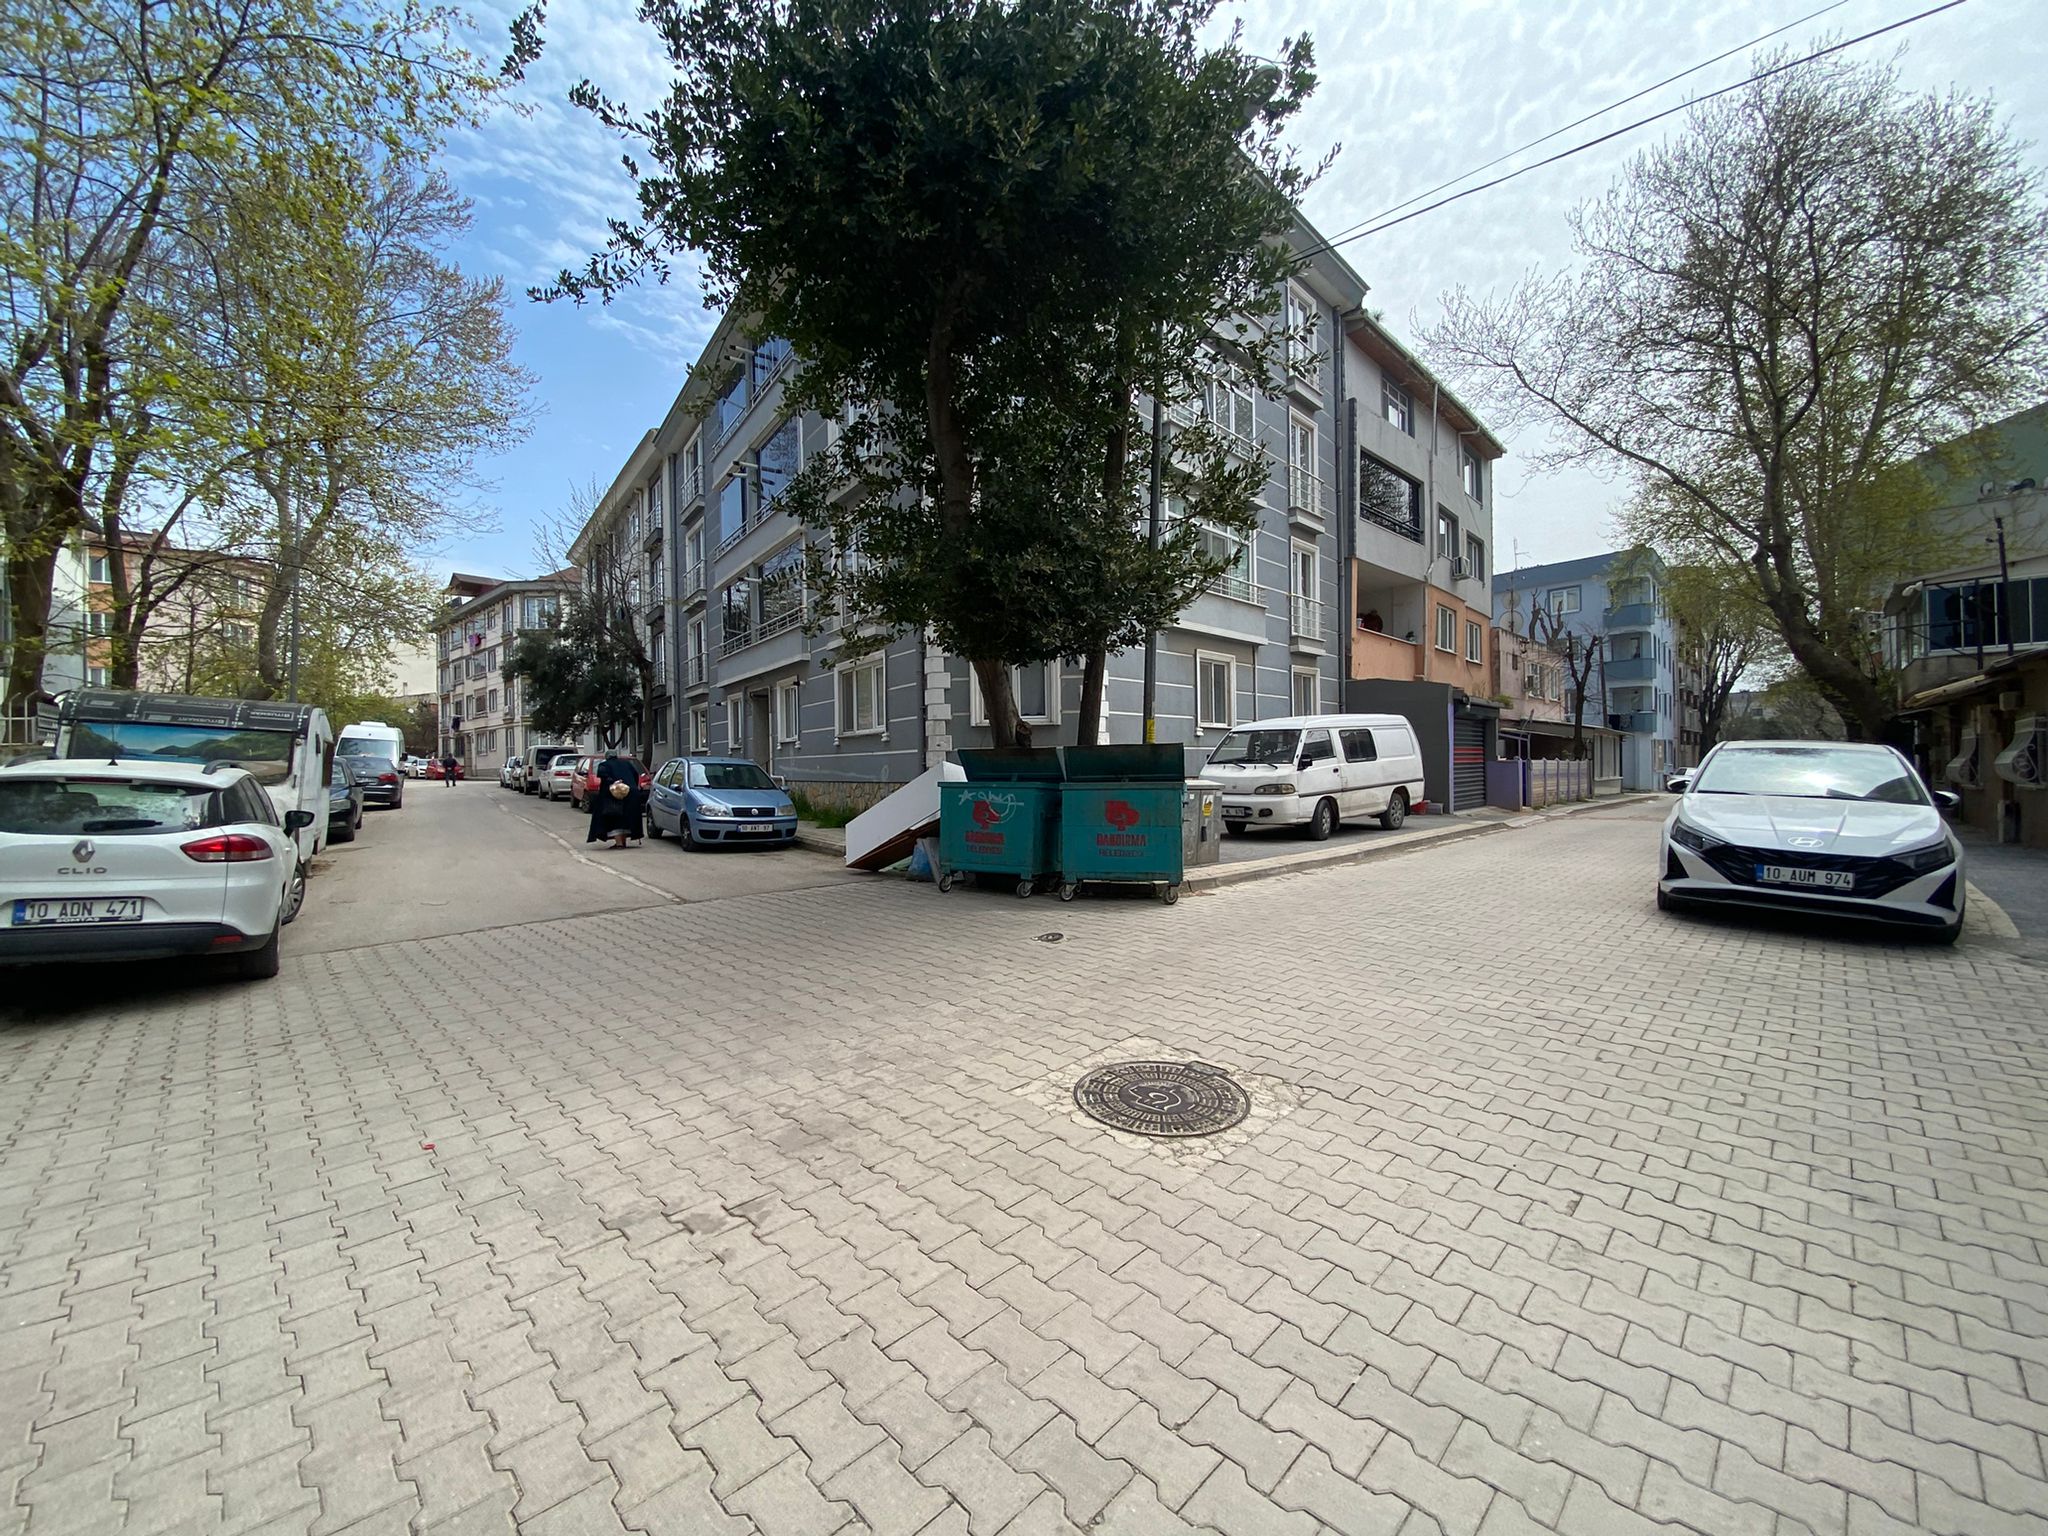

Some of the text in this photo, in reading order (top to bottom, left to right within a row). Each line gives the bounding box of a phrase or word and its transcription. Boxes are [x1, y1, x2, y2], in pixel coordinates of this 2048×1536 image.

[57, 867, 108, 875] CLIO
[1766, 867, 1851, 887] 10 AUM 974
[30, 900, 138, 918] 10 ADN 471
